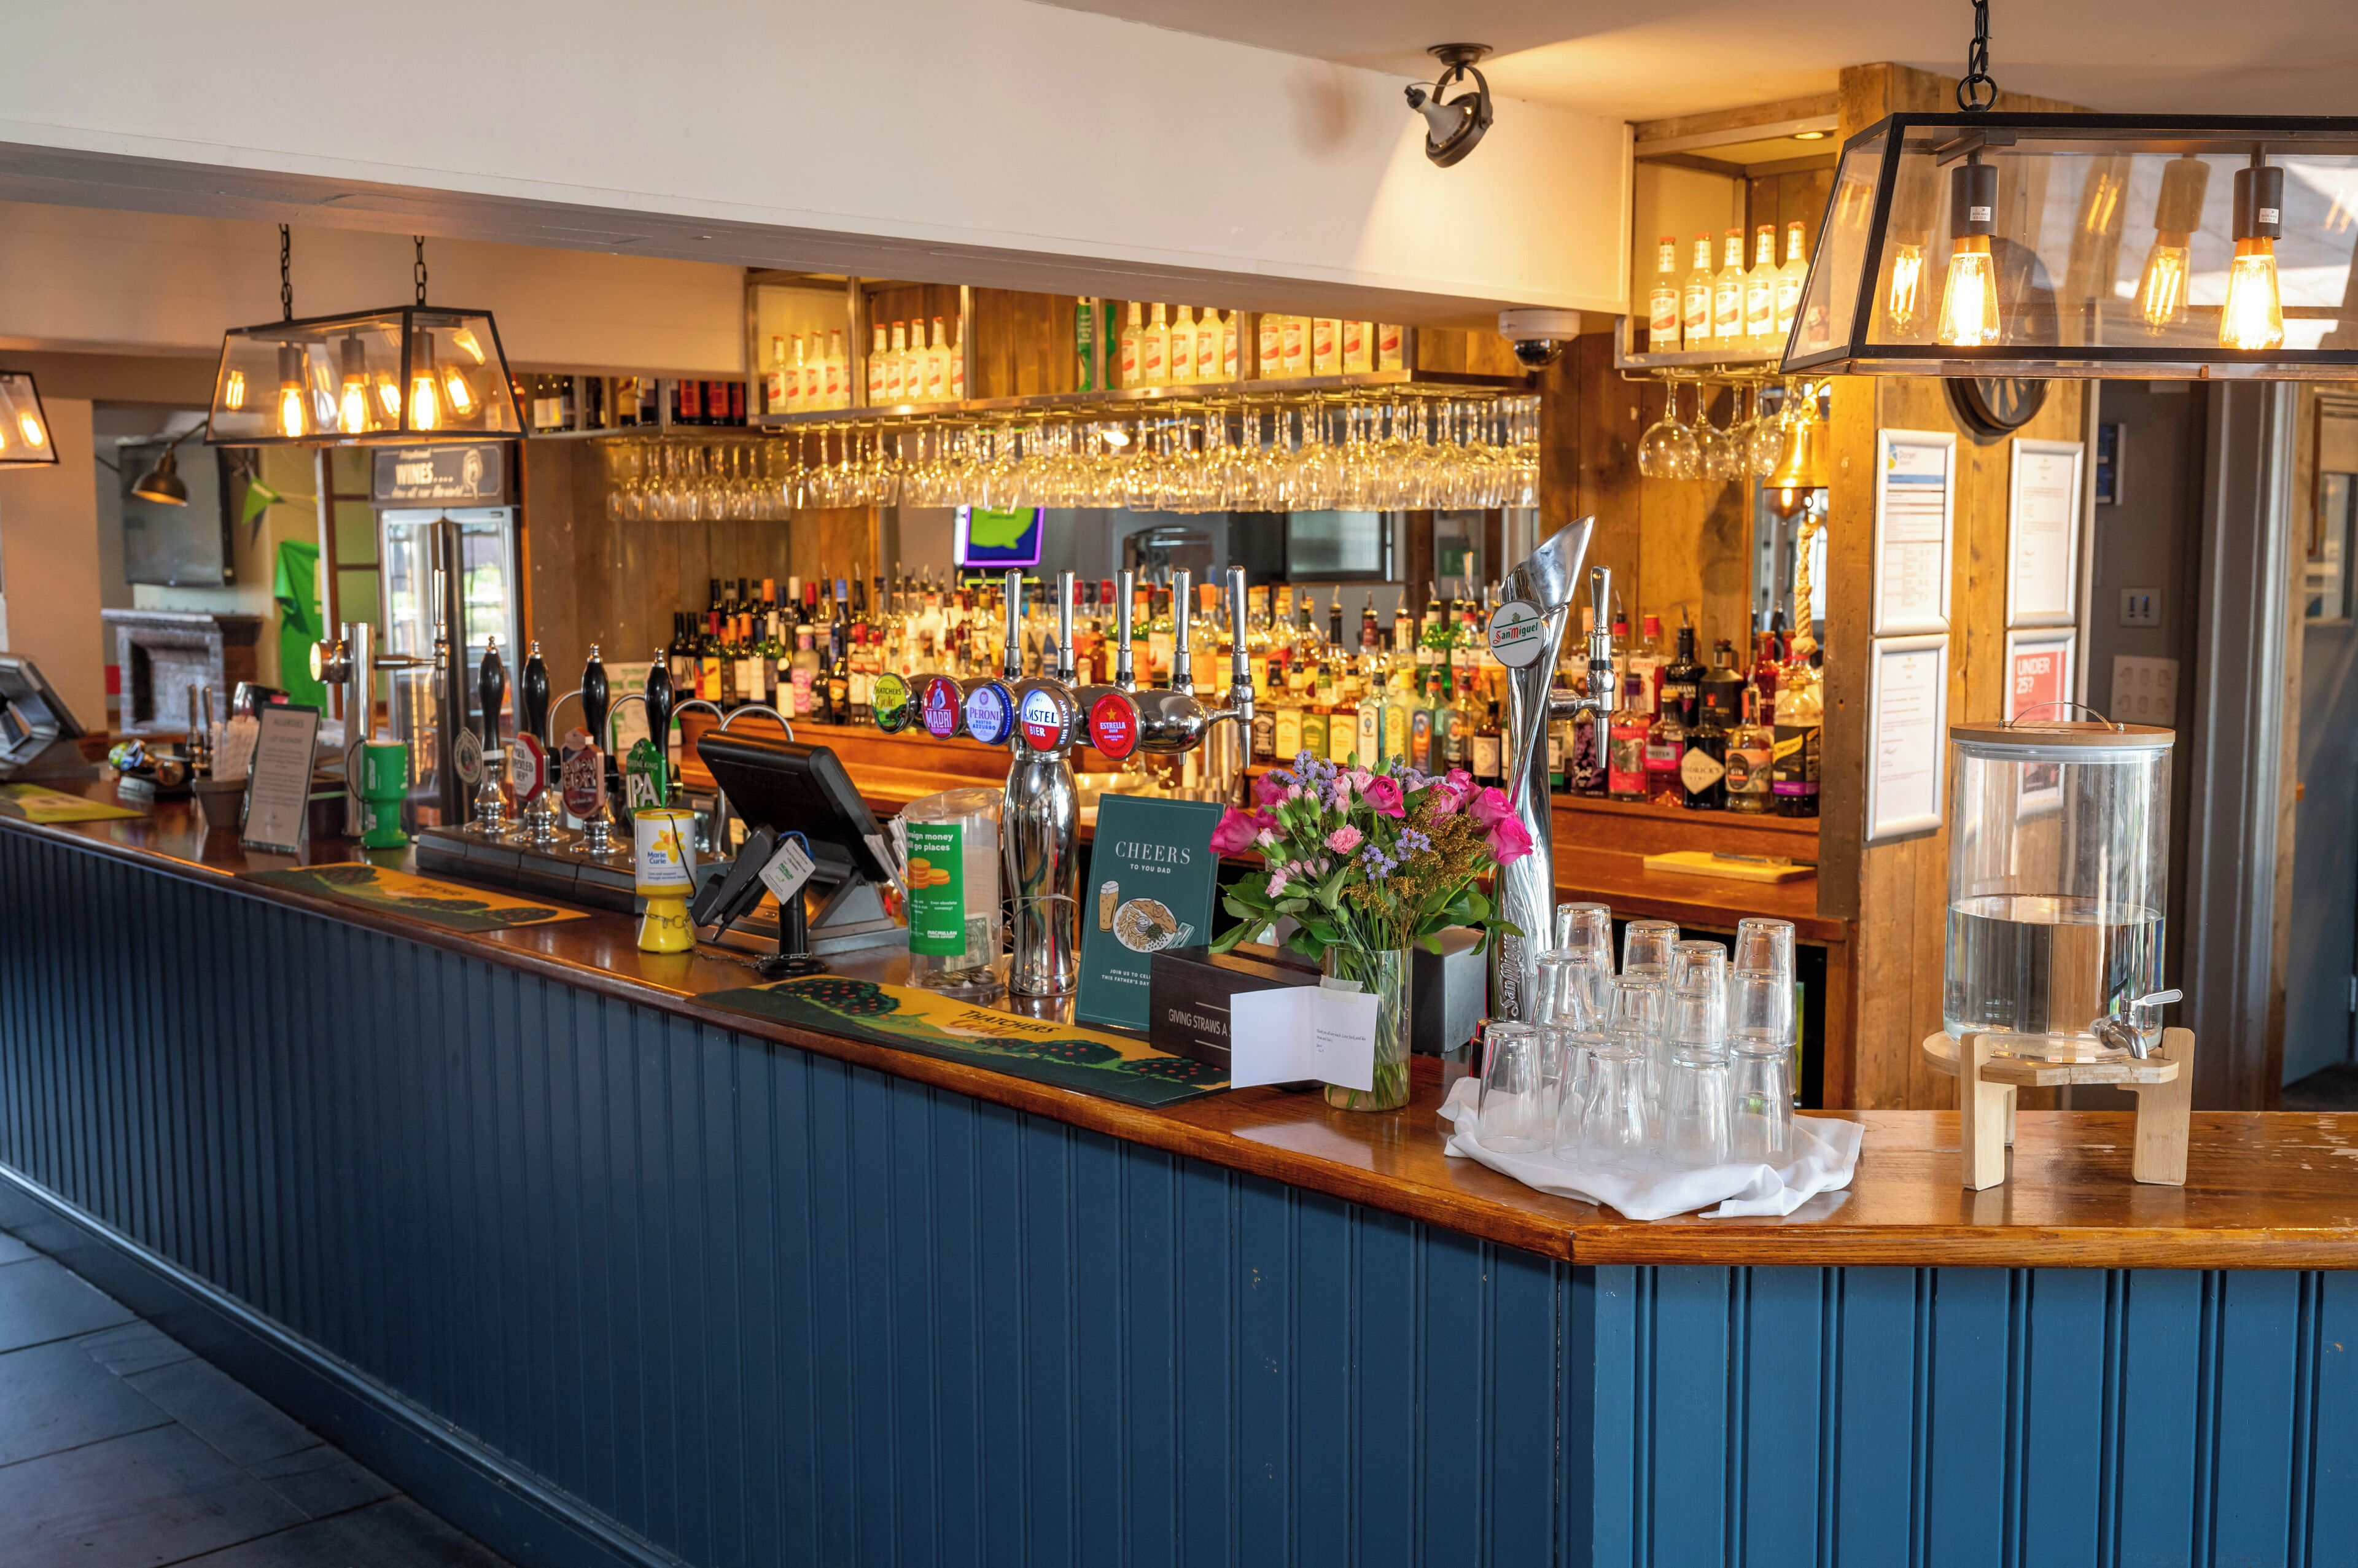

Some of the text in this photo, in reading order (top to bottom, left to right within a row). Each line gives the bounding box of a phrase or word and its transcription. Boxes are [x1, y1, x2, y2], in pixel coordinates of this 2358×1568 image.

[2016, 656, 2051, 677] UNDER
[2015, 676, 2035, 694] 25?
[876, 696, 896, 708] Gold
[969, 707, 1000, 721] PERONI
[1024, 707, 1057, 724] AMSTEL
[1029, 725, 1046, 737] BIER
[1099, 721, 1126, 730] ESTRELLA
[626, 772, 662, 809] IPA
[925, 834, 954, 842] money
[924, 842, 951, 852] places
[1115, 840, 1191, 864] CHEERS
[946, 1019, 1022, 1036] Gold
[959, 1009, 1061, 1034] THATCHERS
[1169, 1008, 1192, 1027] GIVING
[1193, 1015, 1221, 1035] STRAWS
[1221, 1024, 1228, 1037] A
